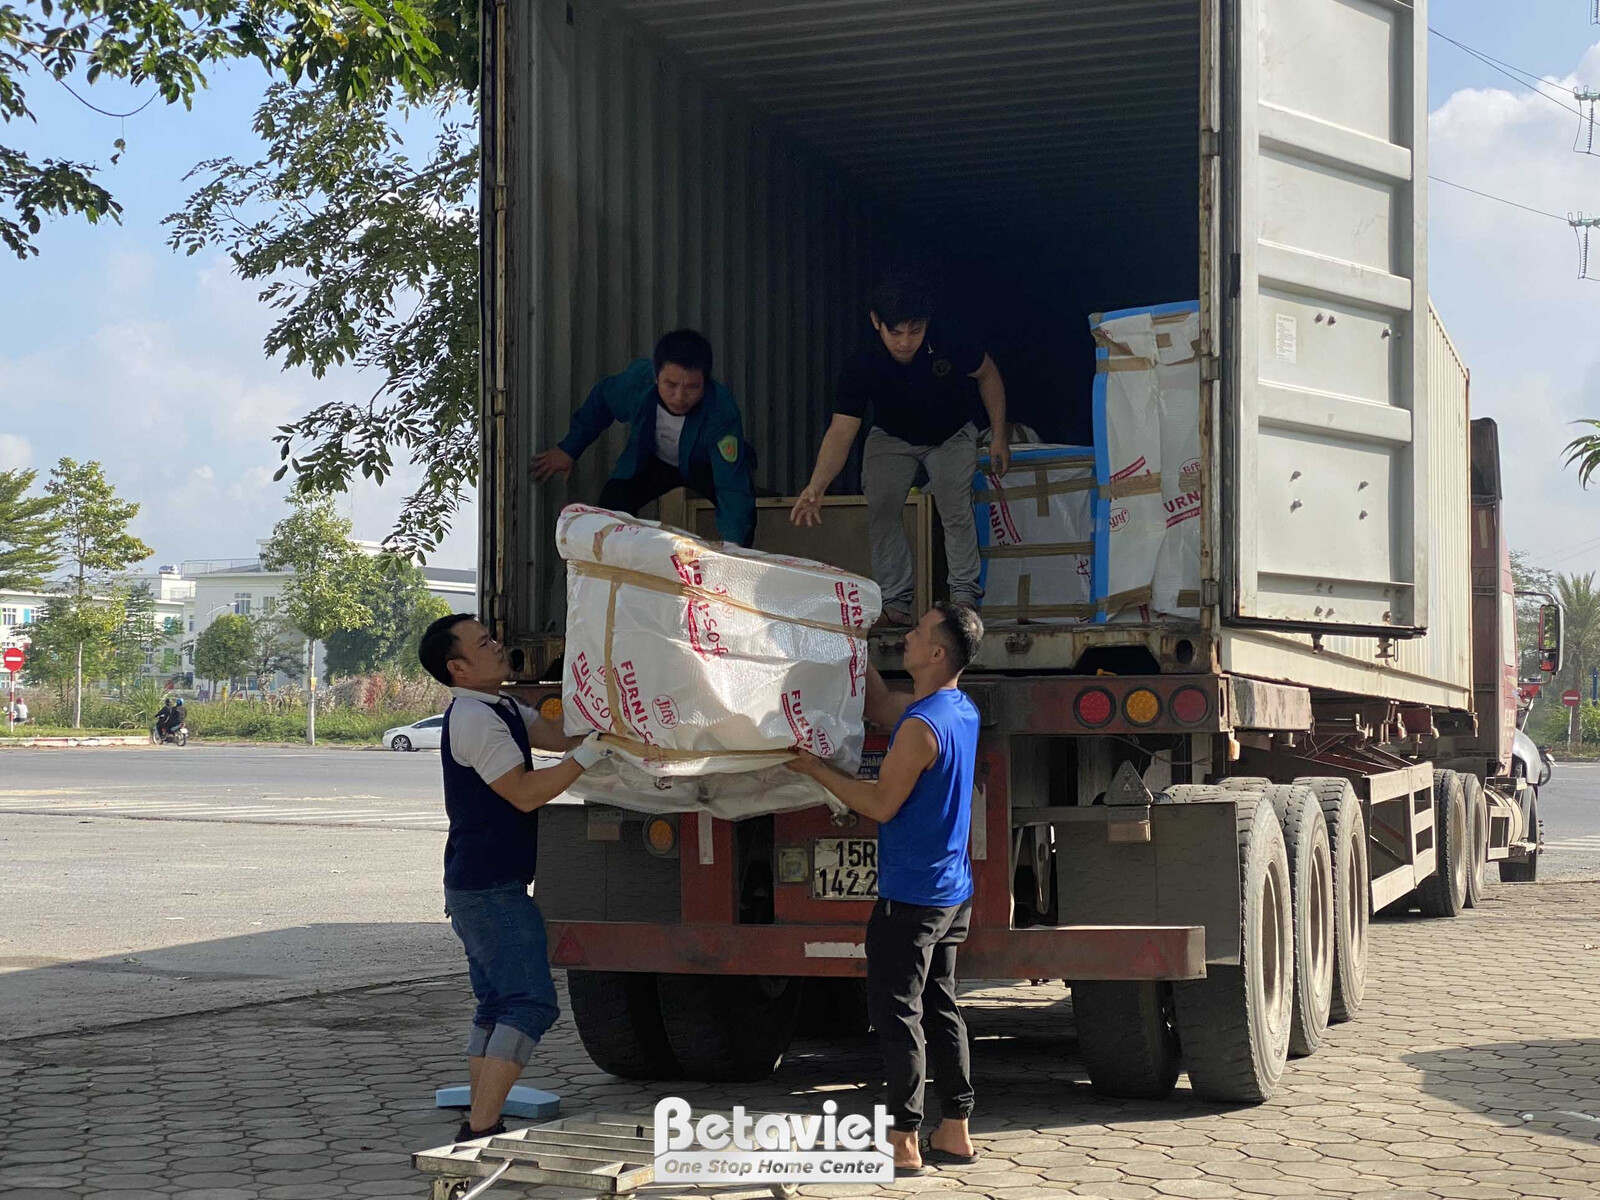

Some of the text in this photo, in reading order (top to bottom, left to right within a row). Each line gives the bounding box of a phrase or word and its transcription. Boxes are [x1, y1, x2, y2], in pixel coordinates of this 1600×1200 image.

[1163, 491, 1201, 513] URN
[655, 697, 677, 726] Jiffy
[836, 840, 877, 868] 15R
[819, 869, 878, 896] 142.2
